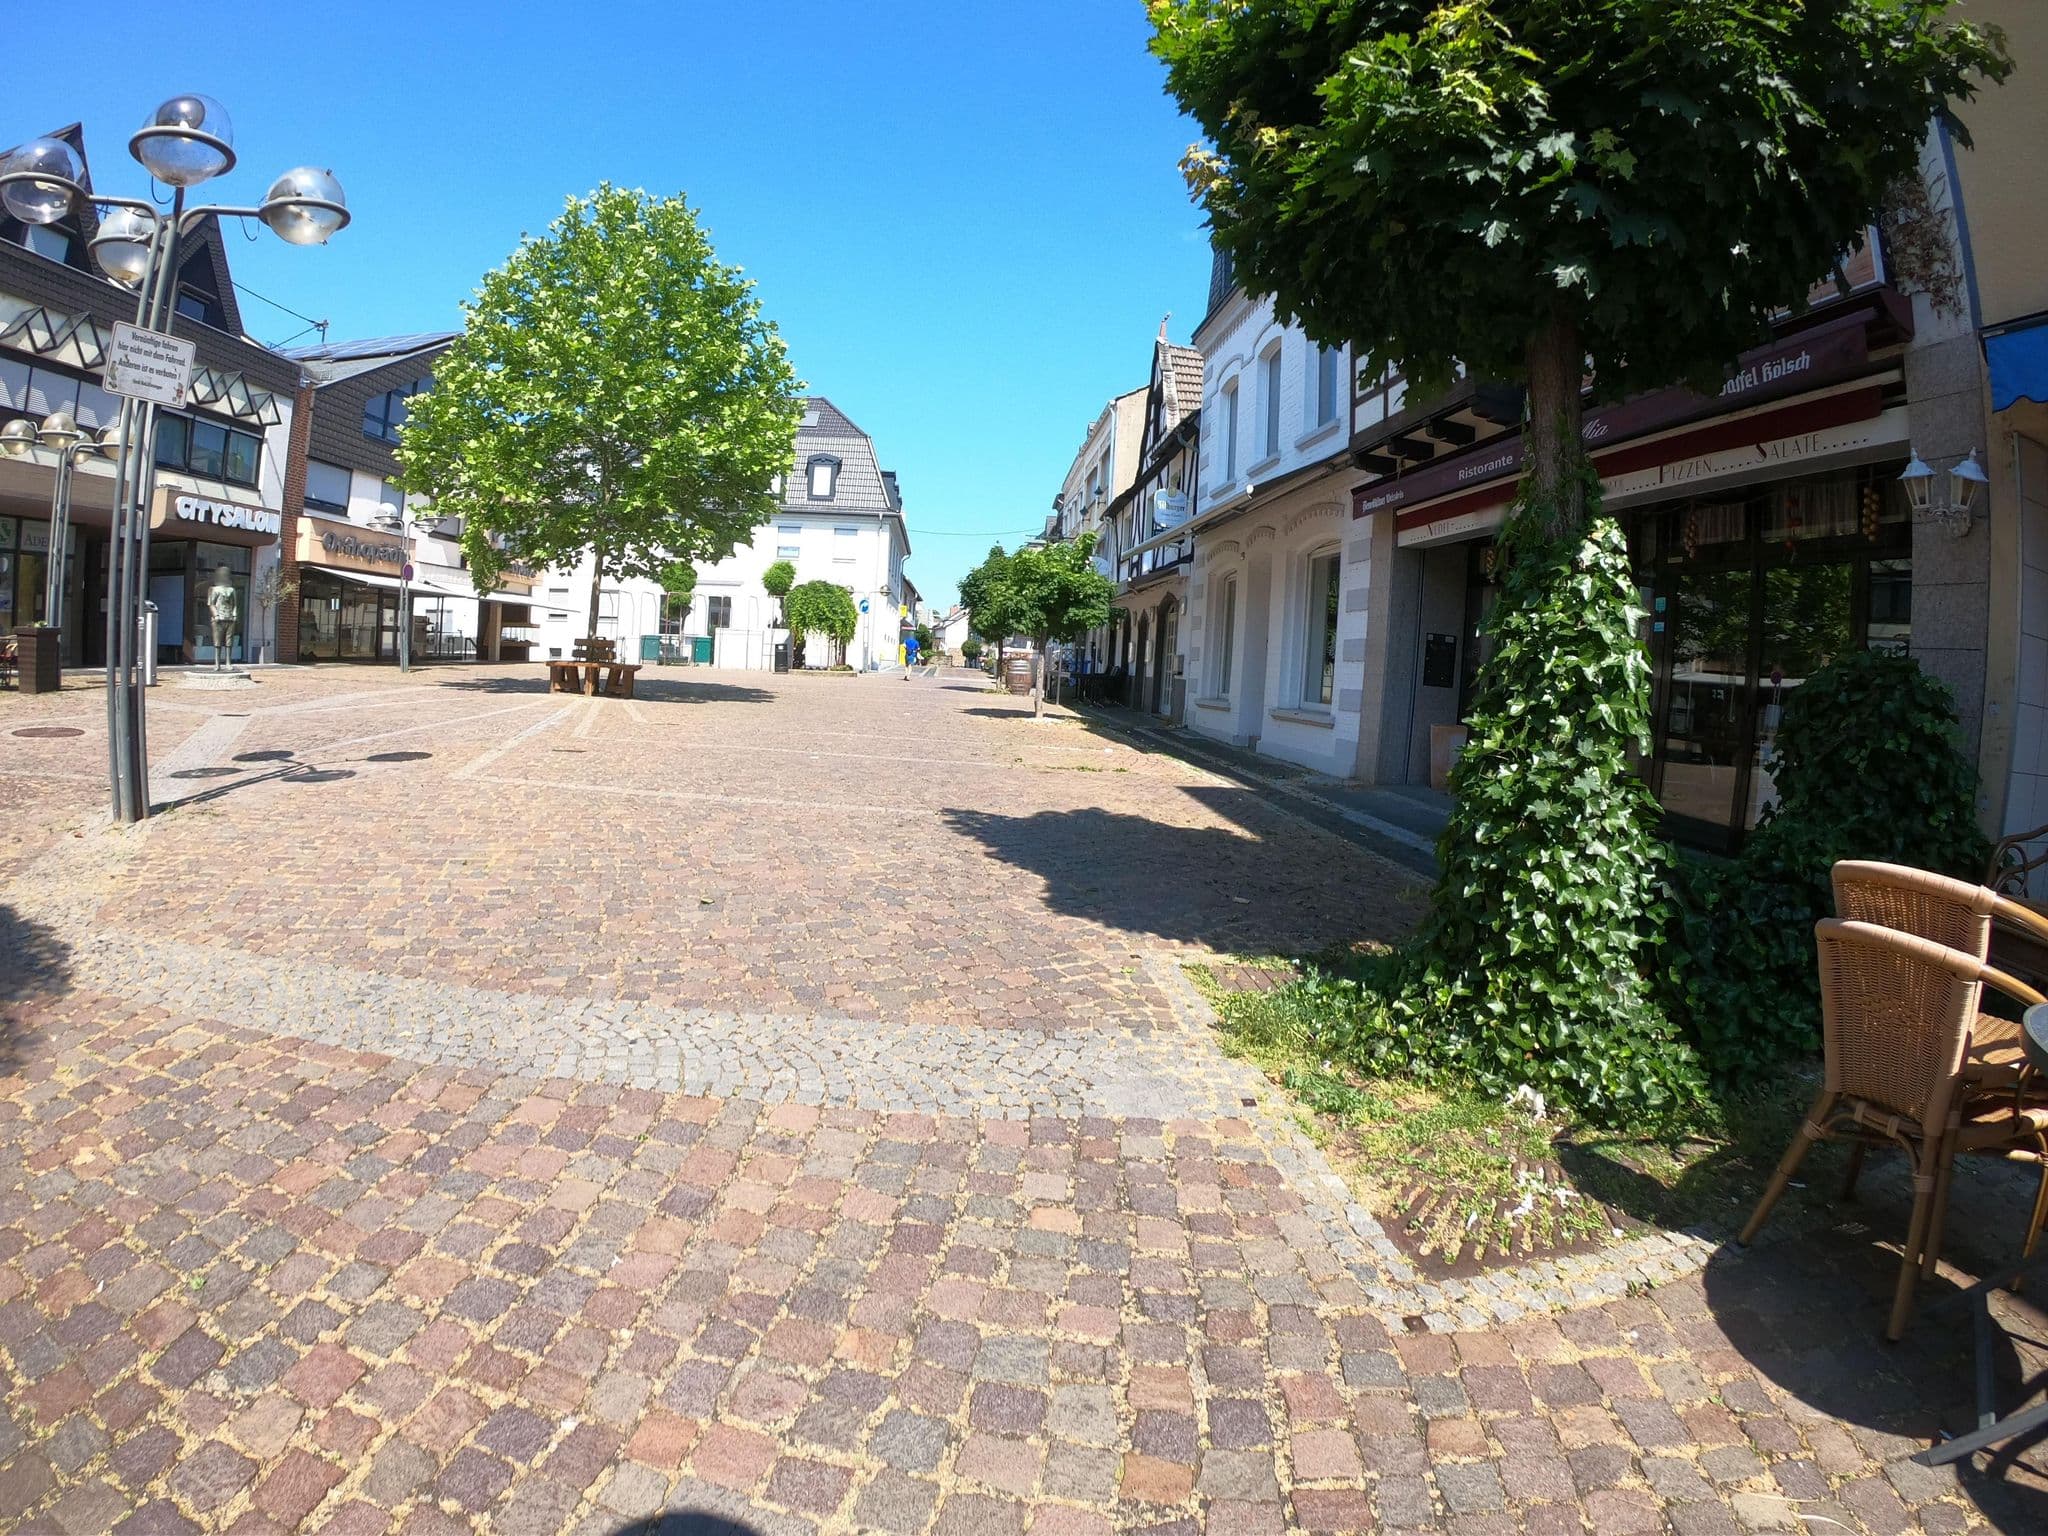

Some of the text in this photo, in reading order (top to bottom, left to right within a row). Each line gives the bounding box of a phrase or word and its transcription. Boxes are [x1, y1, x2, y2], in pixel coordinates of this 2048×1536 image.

[118, 341, 129, 351] hier
[129, 345, 143, 355] nicht
[143, 348, 153, 358] mit
[153, 351, 165, 361] dem
[141, 363, 149, 373] ist
[149, 366, 155, 375] es
[1719, 350, 1811, 397] affel Kölsch
[1458, 454, 1514, 481] Ristorante
[175, 496, 279, 534] CITYSALON
